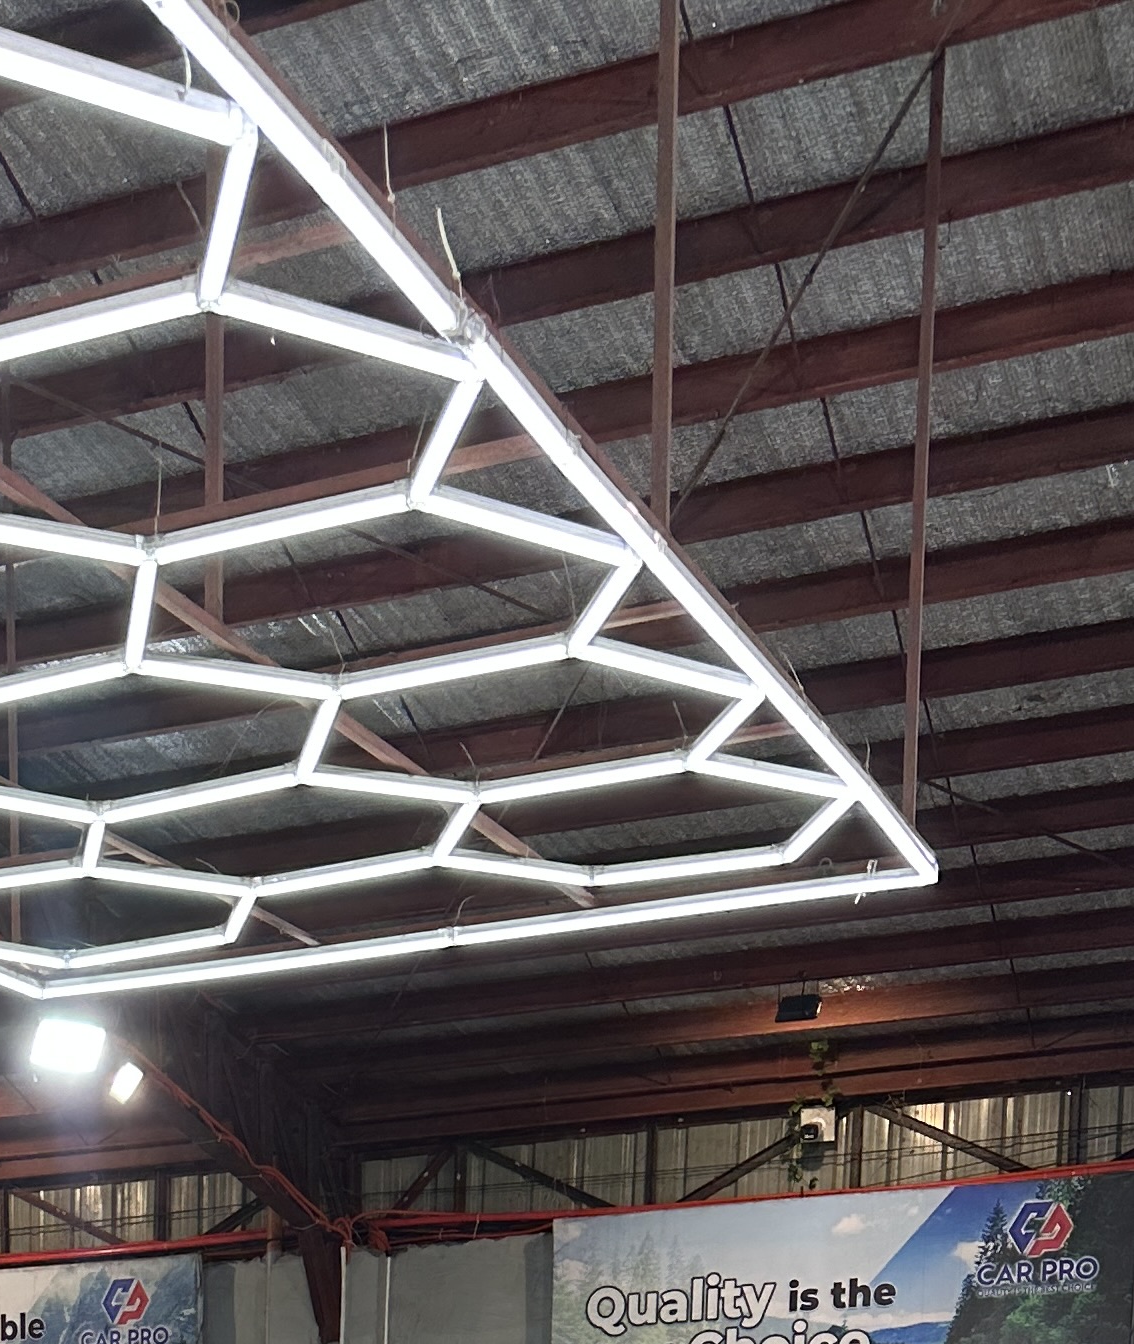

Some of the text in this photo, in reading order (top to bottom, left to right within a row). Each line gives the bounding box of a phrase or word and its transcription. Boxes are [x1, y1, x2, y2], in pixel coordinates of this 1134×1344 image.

[976, 1256, 1099, 1287] CAR PRO
[586, 1272, 896, 1336] Quality is the
